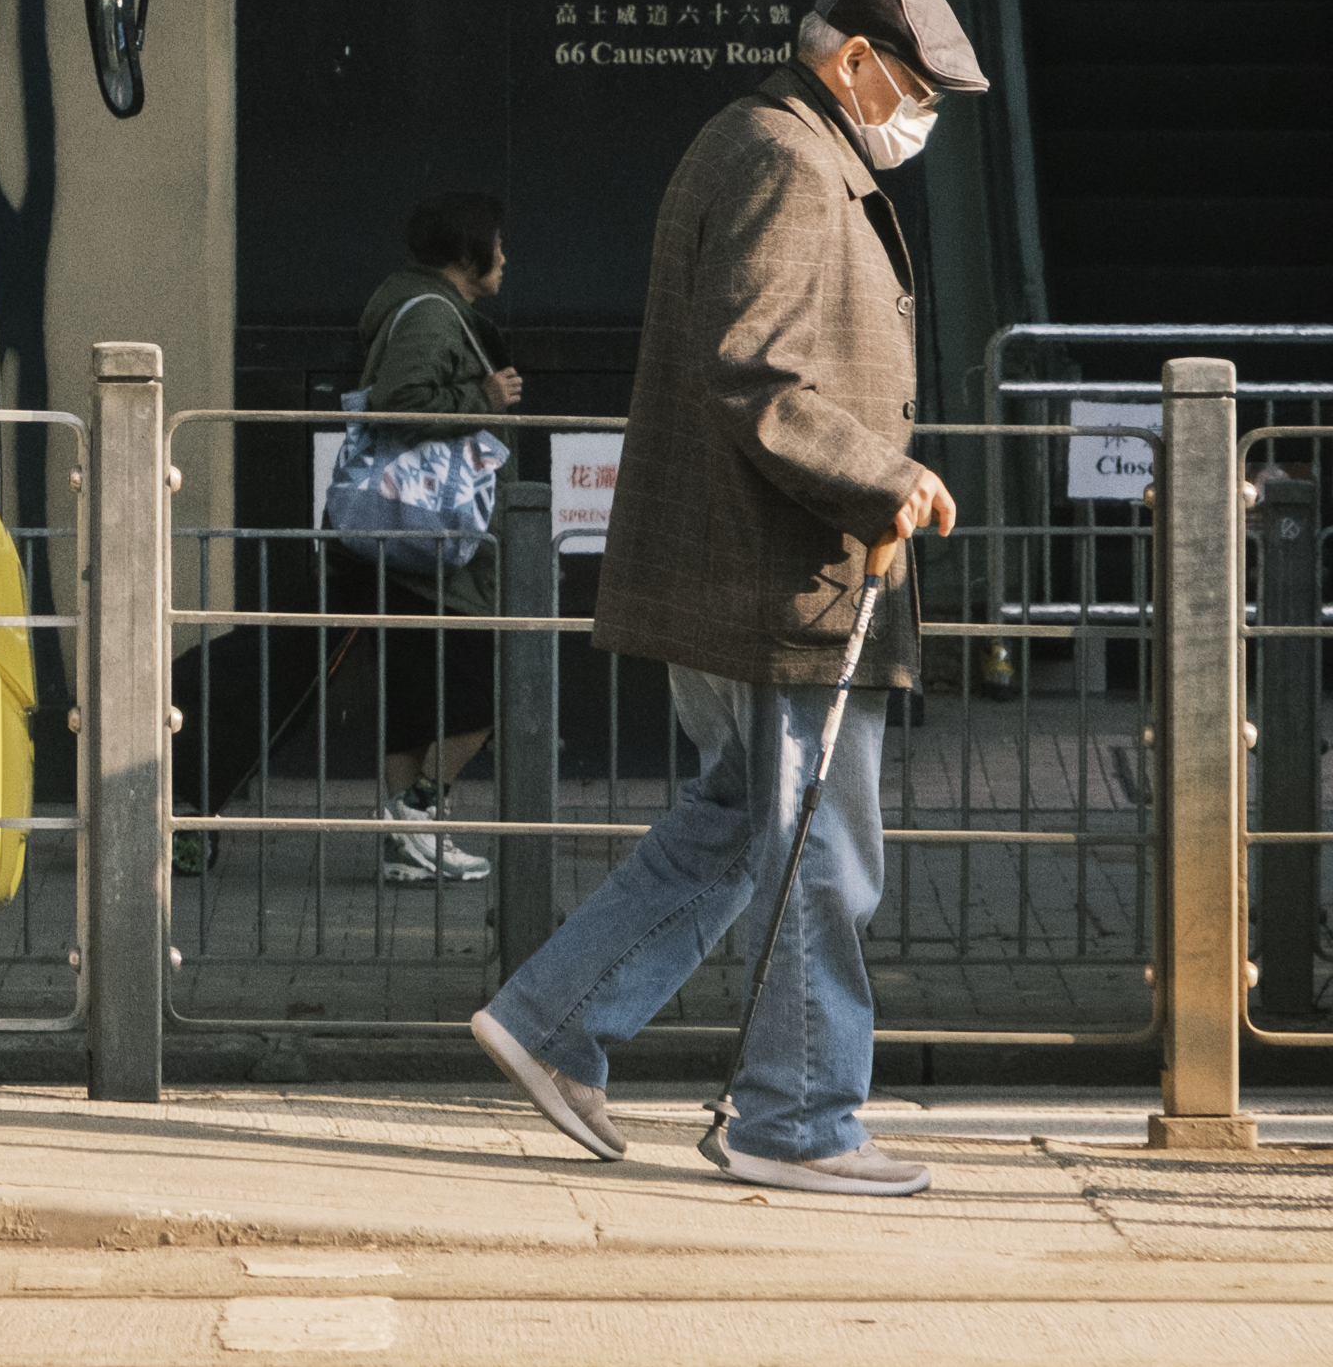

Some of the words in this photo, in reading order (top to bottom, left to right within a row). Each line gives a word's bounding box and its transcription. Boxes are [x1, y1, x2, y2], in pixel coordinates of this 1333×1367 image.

[555, 3, 792, 25] 高士威道六十六號
[555, 42, 585, 65] 66
[590, 41, 718, 70] Causeway
[726, 41, 792, 65] Road
